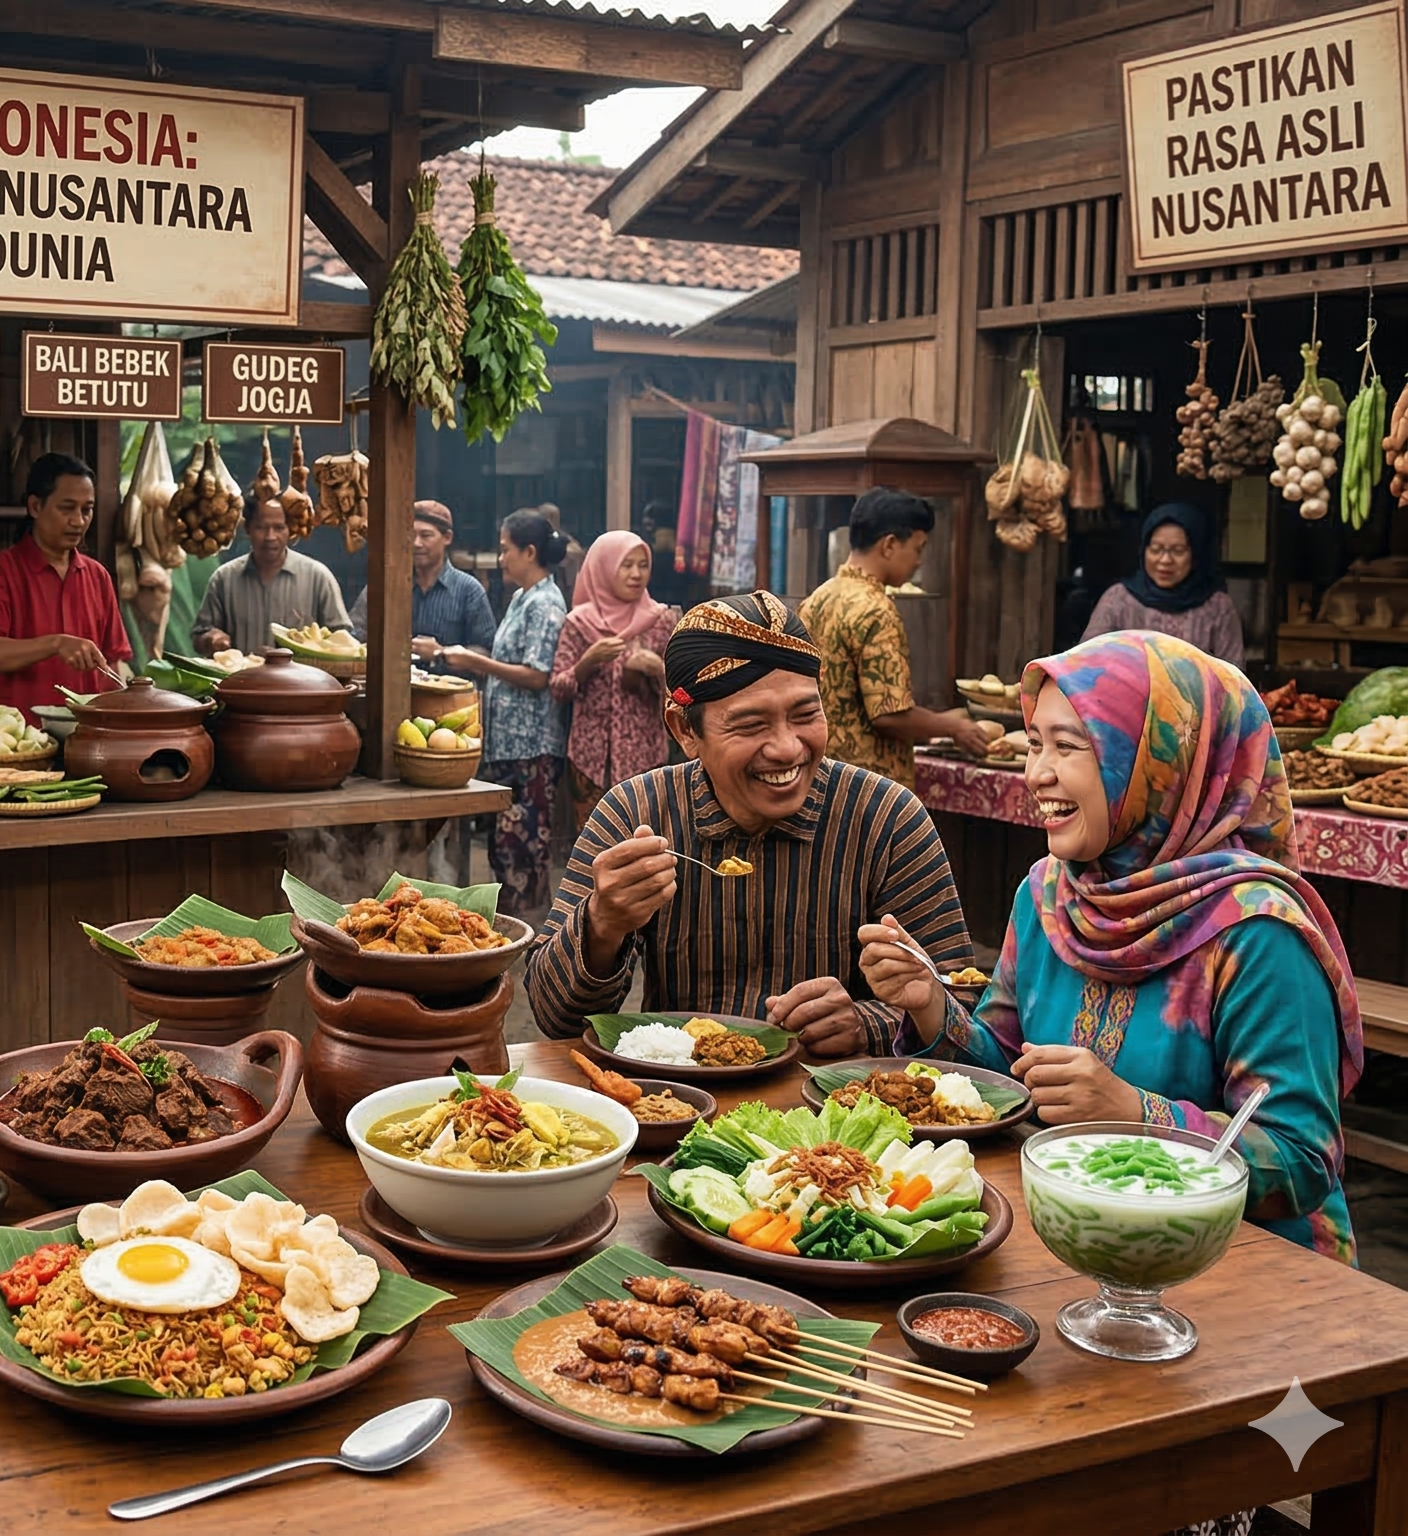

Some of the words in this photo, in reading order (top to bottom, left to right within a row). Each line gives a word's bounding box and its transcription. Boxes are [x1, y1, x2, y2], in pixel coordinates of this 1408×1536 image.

[1166, 39, 1355, 121] PASTIKAN
[1167, 120, 1266, 179] RASA
[1276, 101, 1365, 162] ASLI
[1151, 161, 1391, 239] NUSANTARA
[35, 345, 88, 373] BALI
[95, 350, 170, 378] BEBEK
[232, 353, 319, 383] GUDEG
[57, 379, 148, 408] BETUTU
[237, 385, 313, 415] JOGJA
